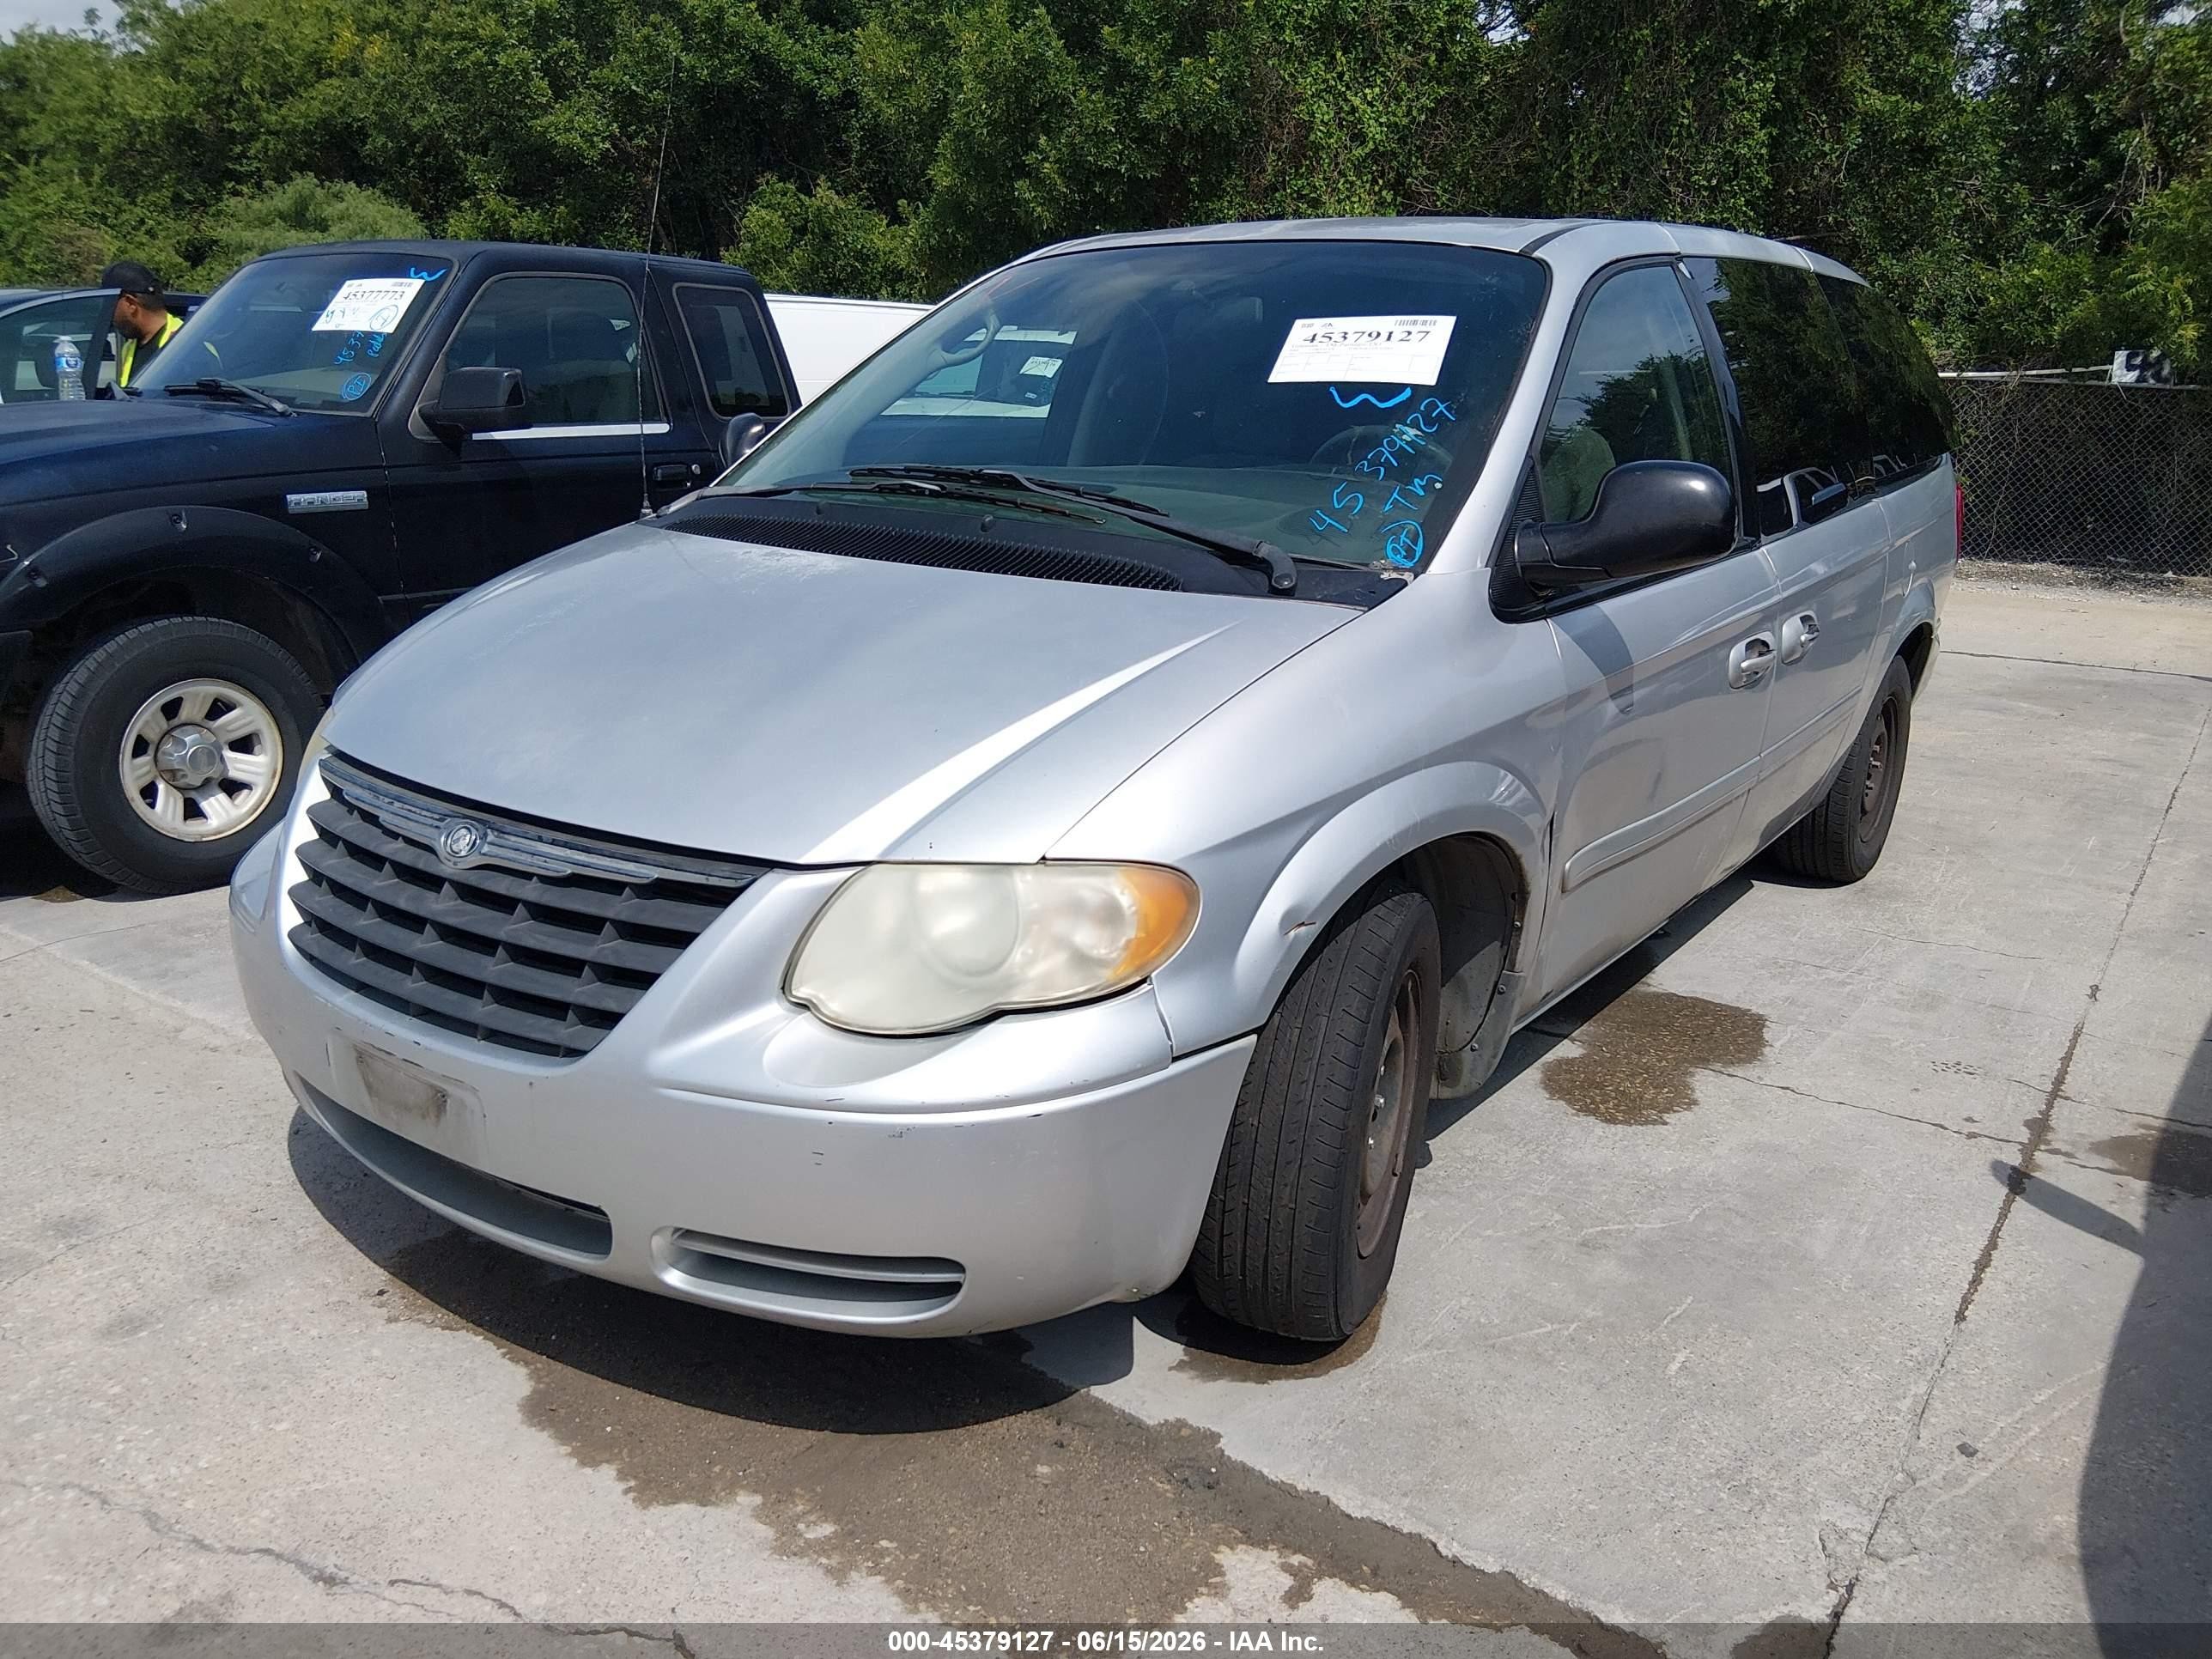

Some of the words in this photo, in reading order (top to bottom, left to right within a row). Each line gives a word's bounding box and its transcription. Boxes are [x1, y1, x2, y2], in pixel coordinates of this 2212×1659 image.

[343, 290, 405, 301] 45377773
[1303, 330, 1431, 343] 45379127
[288, 493, 368, 509] RANGER
